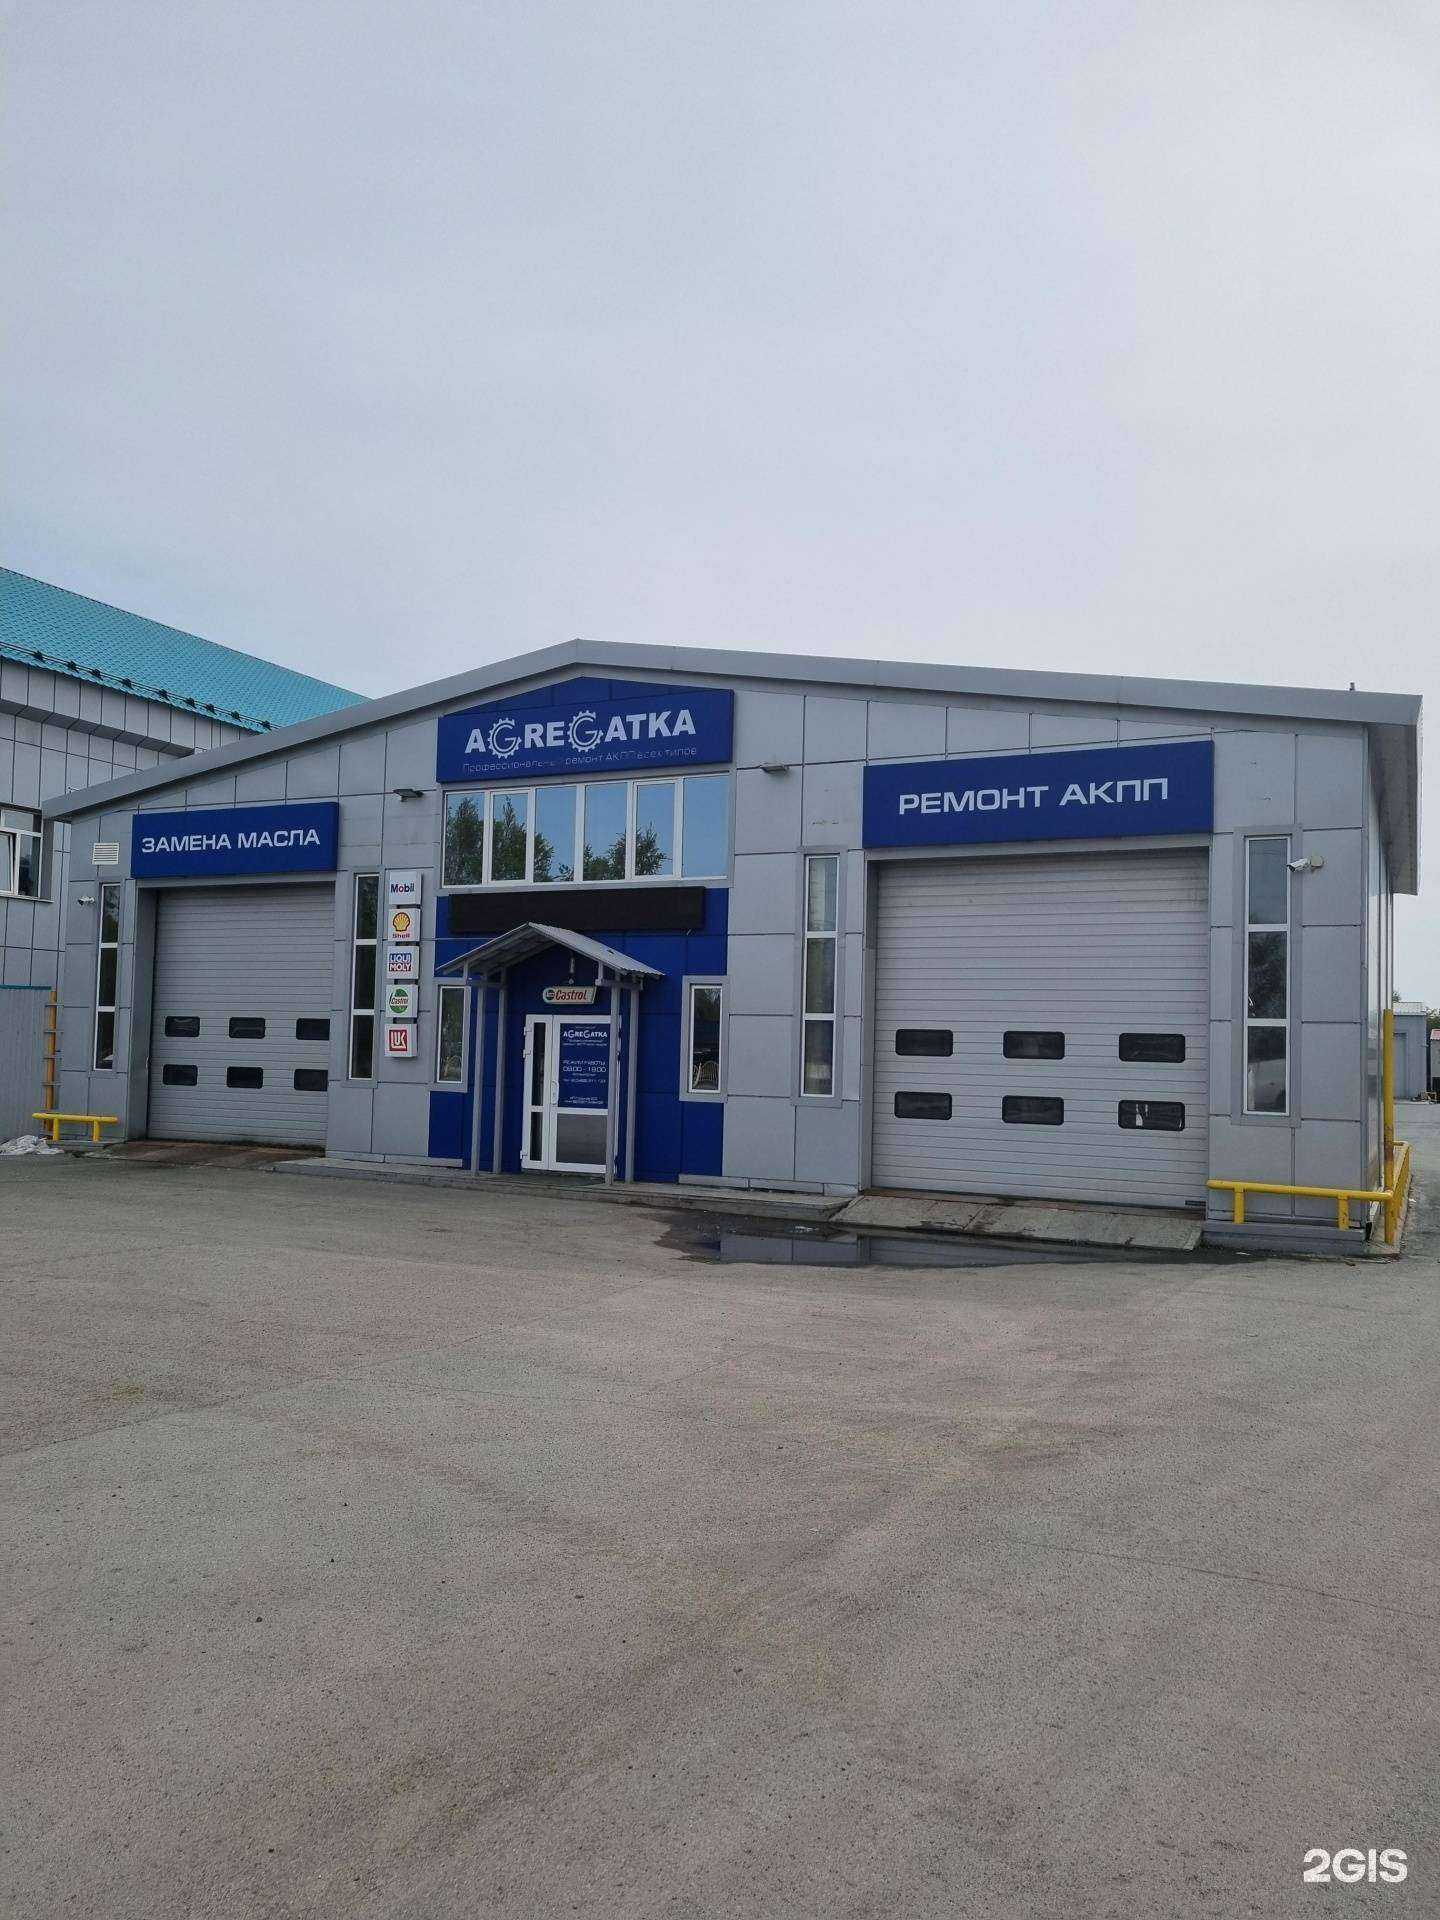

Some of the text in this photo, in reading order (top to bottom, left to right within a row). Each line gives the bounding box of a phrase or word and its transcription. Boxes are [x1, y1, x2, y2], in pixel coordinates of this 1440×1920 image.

[464, 710, 697, 759] AGREGATKA
[463, 762, 558, 773] Профессиональ
[899, 778, 1168, 815] РЕМОНТ АКПП
[142, 829, 320, 853] ЗАМЕНА МАСЛА
[390, 883, 415, 893] Mobil
[390, 953, 411, 961] LIQUI
[389, 963, 411, 971] MOLY
[555, 990, 587, 1001] Castrol
